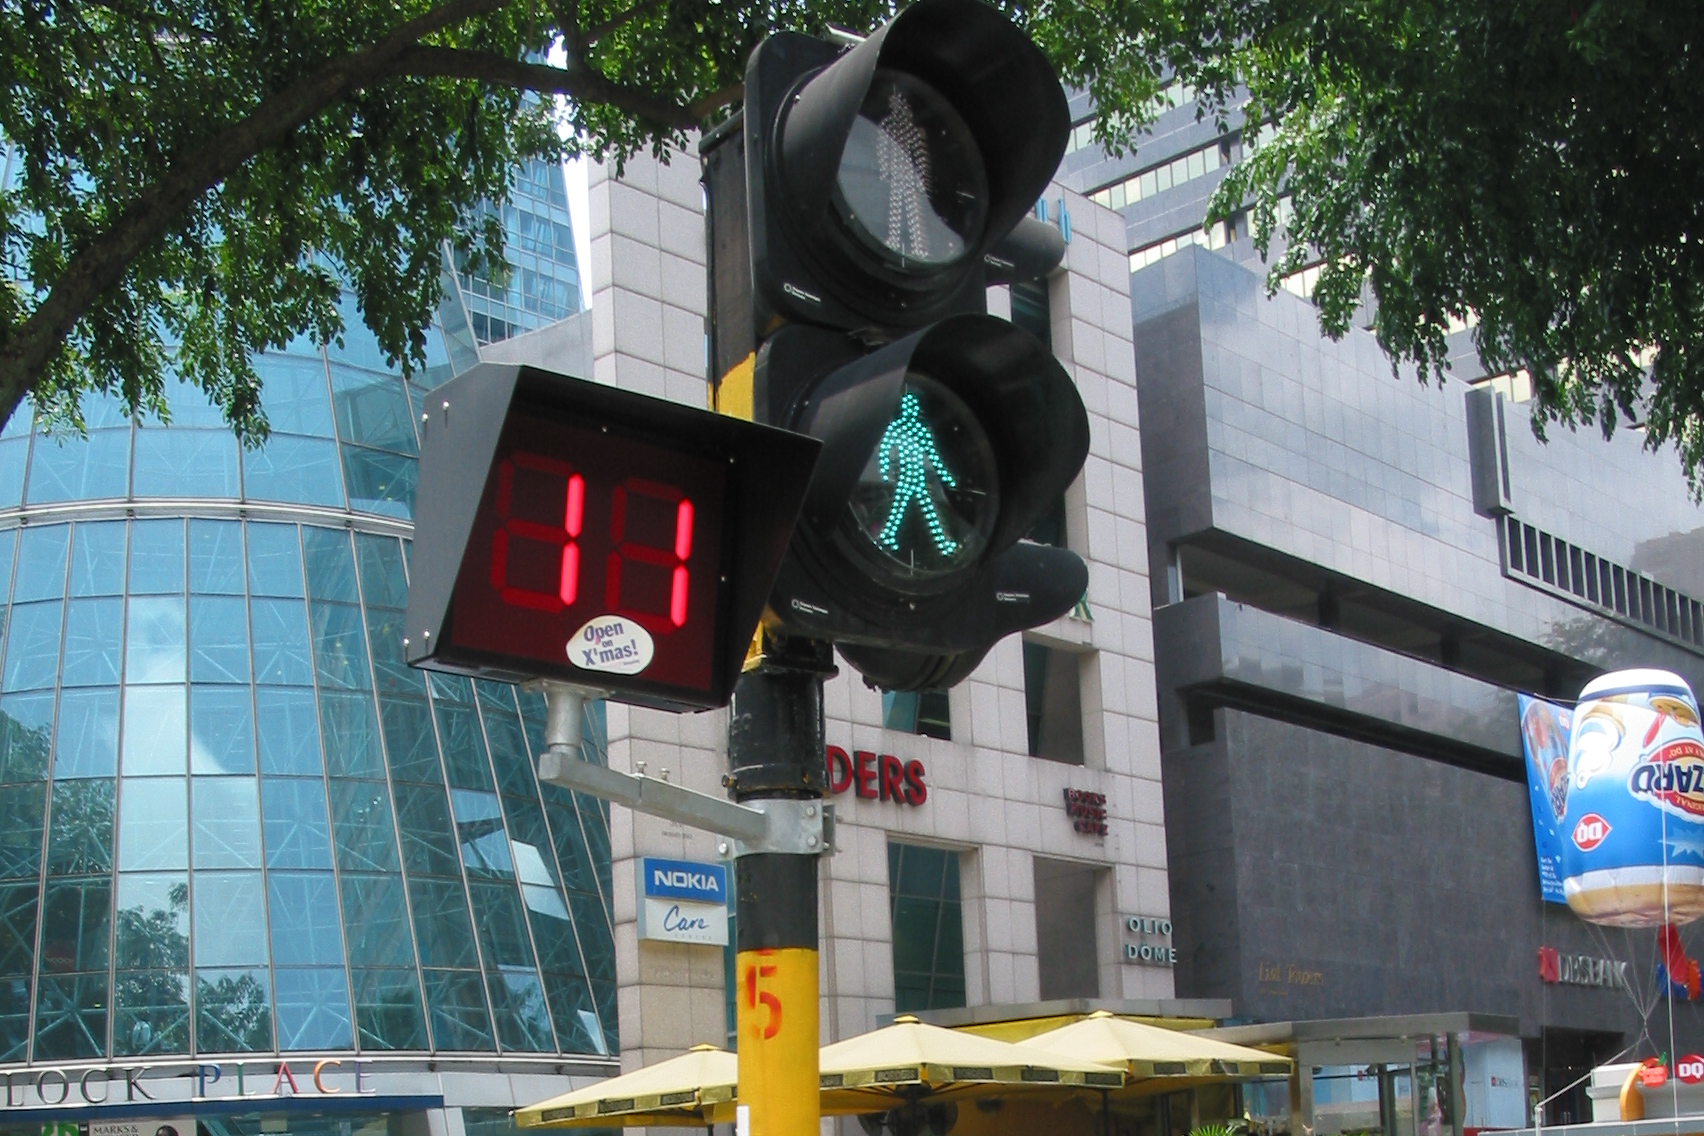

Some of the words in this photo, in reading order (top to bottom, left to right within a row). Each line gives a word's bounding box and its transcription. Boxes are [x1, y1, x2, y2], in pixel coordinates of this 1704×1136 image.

[583, 621, 625, 645] Open
[601, 639, 614, 648] on
[582, 638, 639, 666] X'mas!
[826, 745, 928, 807] DERS
[1577, 821, 1601, 843] DQ
[654, 870, 720, 892] NOKIA
[663, 904, 710, 932] Care
[1128, 917, 1174, 936] OLIO
[744, 965, 783, 1041] 5
[5, 1066, 157, 1106] LOCK
[198, 1059, 377, 1099] PLACE
[1679, 1062, 1704, 1079] DQ
